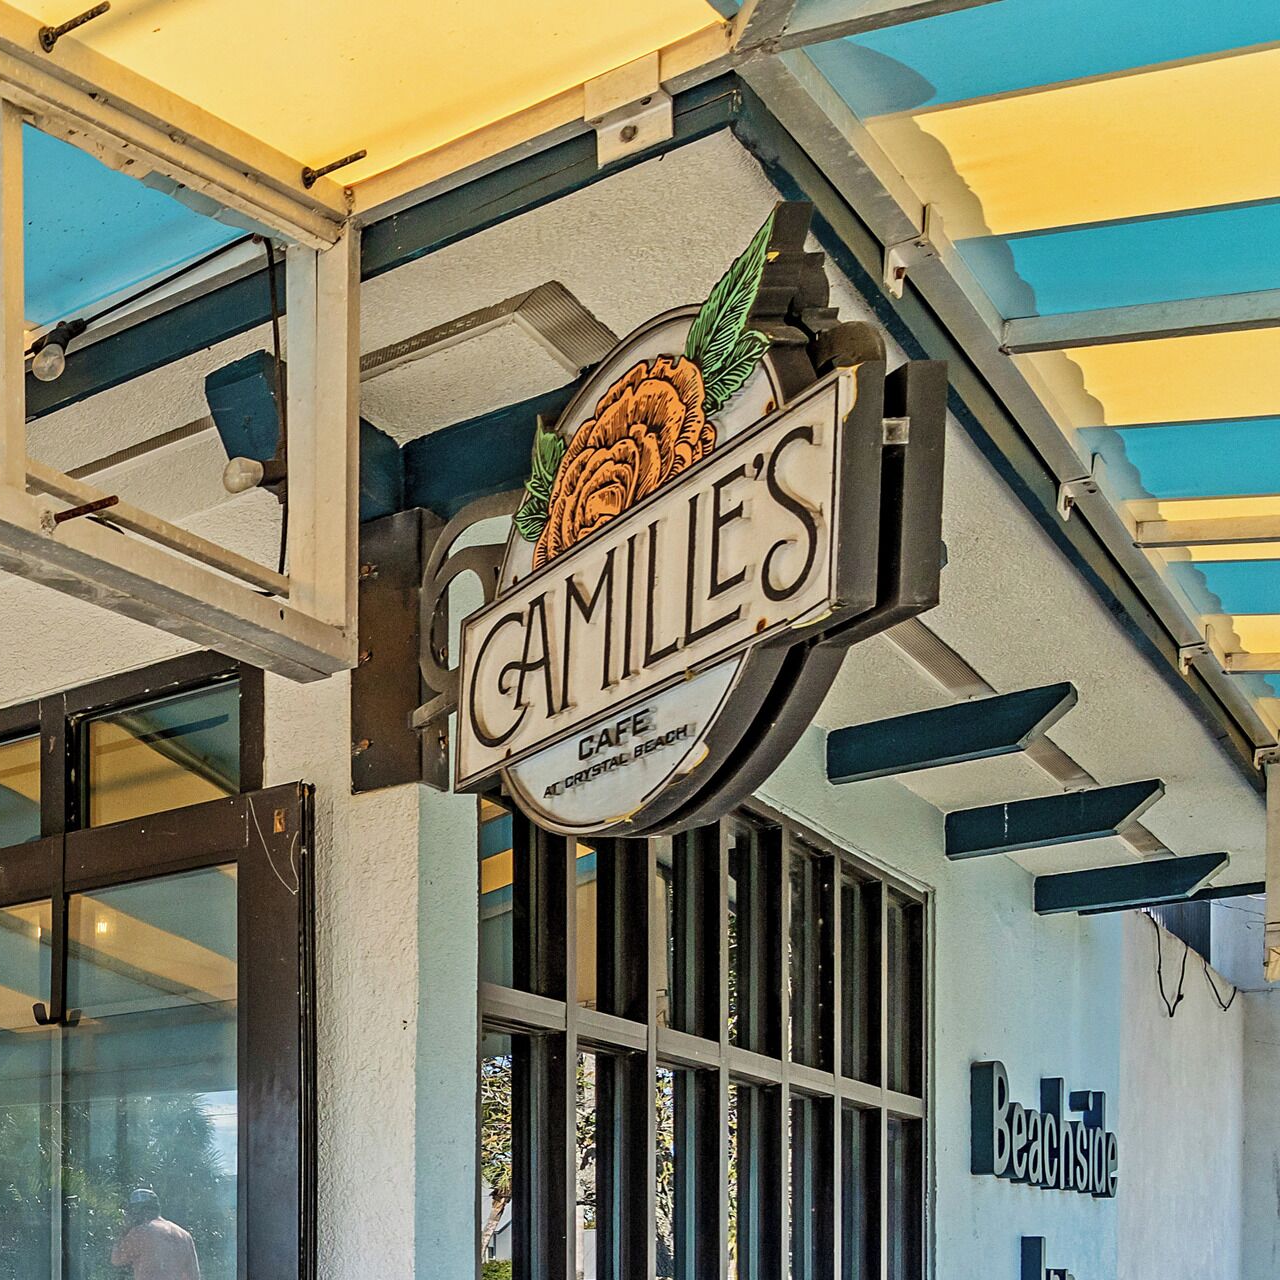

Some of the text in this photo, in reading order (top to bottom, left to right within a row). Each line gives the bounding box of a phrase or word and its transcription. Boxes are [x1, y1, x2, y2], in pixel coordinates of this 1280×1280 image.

[470, 426, 818, 748] CAMILLE'S
[544, 724, 688, 798] AT CRYSTAL BEACH
[578, 708, 651, 761] CAFE
[973, 1060, 1119, 1197] Beachside
